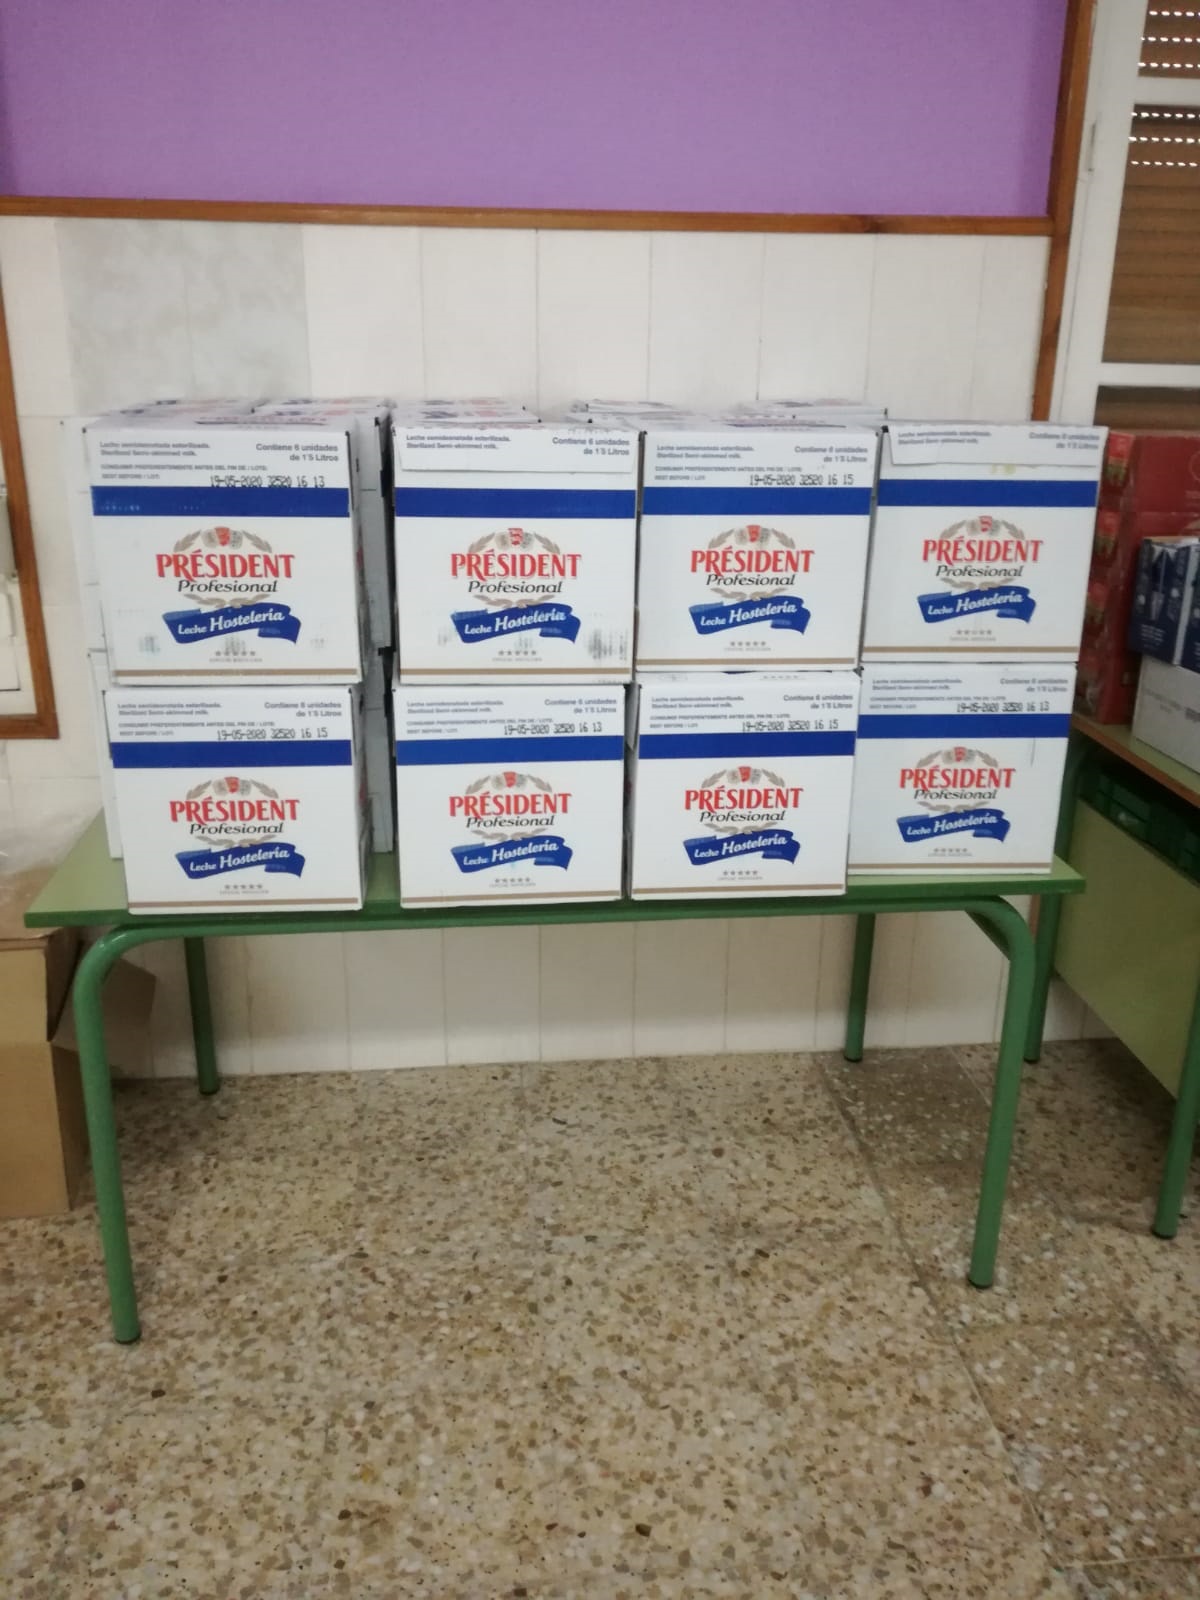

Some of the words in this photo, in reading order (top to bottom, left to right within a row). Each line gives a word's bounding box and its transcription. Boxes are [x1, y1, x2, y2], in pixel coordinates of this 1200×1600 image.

[690, 546, 815, 577] PRÉSIDENT
[922, 537, 1045, 566] PRÉSIDENT
[155, 549, 295, 582] PRÉSIDENT
[450, 549, 582, 582] PRÉSIDENT
[935, 564, 1023, 578] Profesional
[177, 580, 278, 594] Profesional
[467, 580, 563, 594] Profesional
[705, 574, 795, 587] Profesional
[700, 615, 726, 627] Leche
[729, 600, 798, 624] Hostelería
[928, 604, 954, 616] Leche
[956, 590, 1024, 613] Hostelería
[178, 622, 207, 635] Leche
[210, 607, 285, 632] Hostelería
[464, 623, 492, 635] Leche
[494, 607, 567, 632] Hostelería
[899, 765, 1017, 793] PRÉSIDENT
[449, 791, 573, 819] PRÉSIDENT
[684, 786, 804, 814] PRÉSIDENT
[913, 788, 998, 801] Profesional
[169, 796, 300, 826] PRÉSIDENT
[465, 815, 555, 828] Profesional
[699, 810, 787, 823] Profesional
[907, 825, 932, 837] Leche
[933, 811, 999, 834] Hostelería
[189, 822, 285, 835] Profesional
[189, 861, 217, 873] Leche
[220, 846, 291, 870] Hostelería
[463, 855, 489, 866] Leche
[492, 839, 560, 863] Hostelería
[694, 848, 719, 859] Leche
[721, 833, 788, 856] Hostelería
